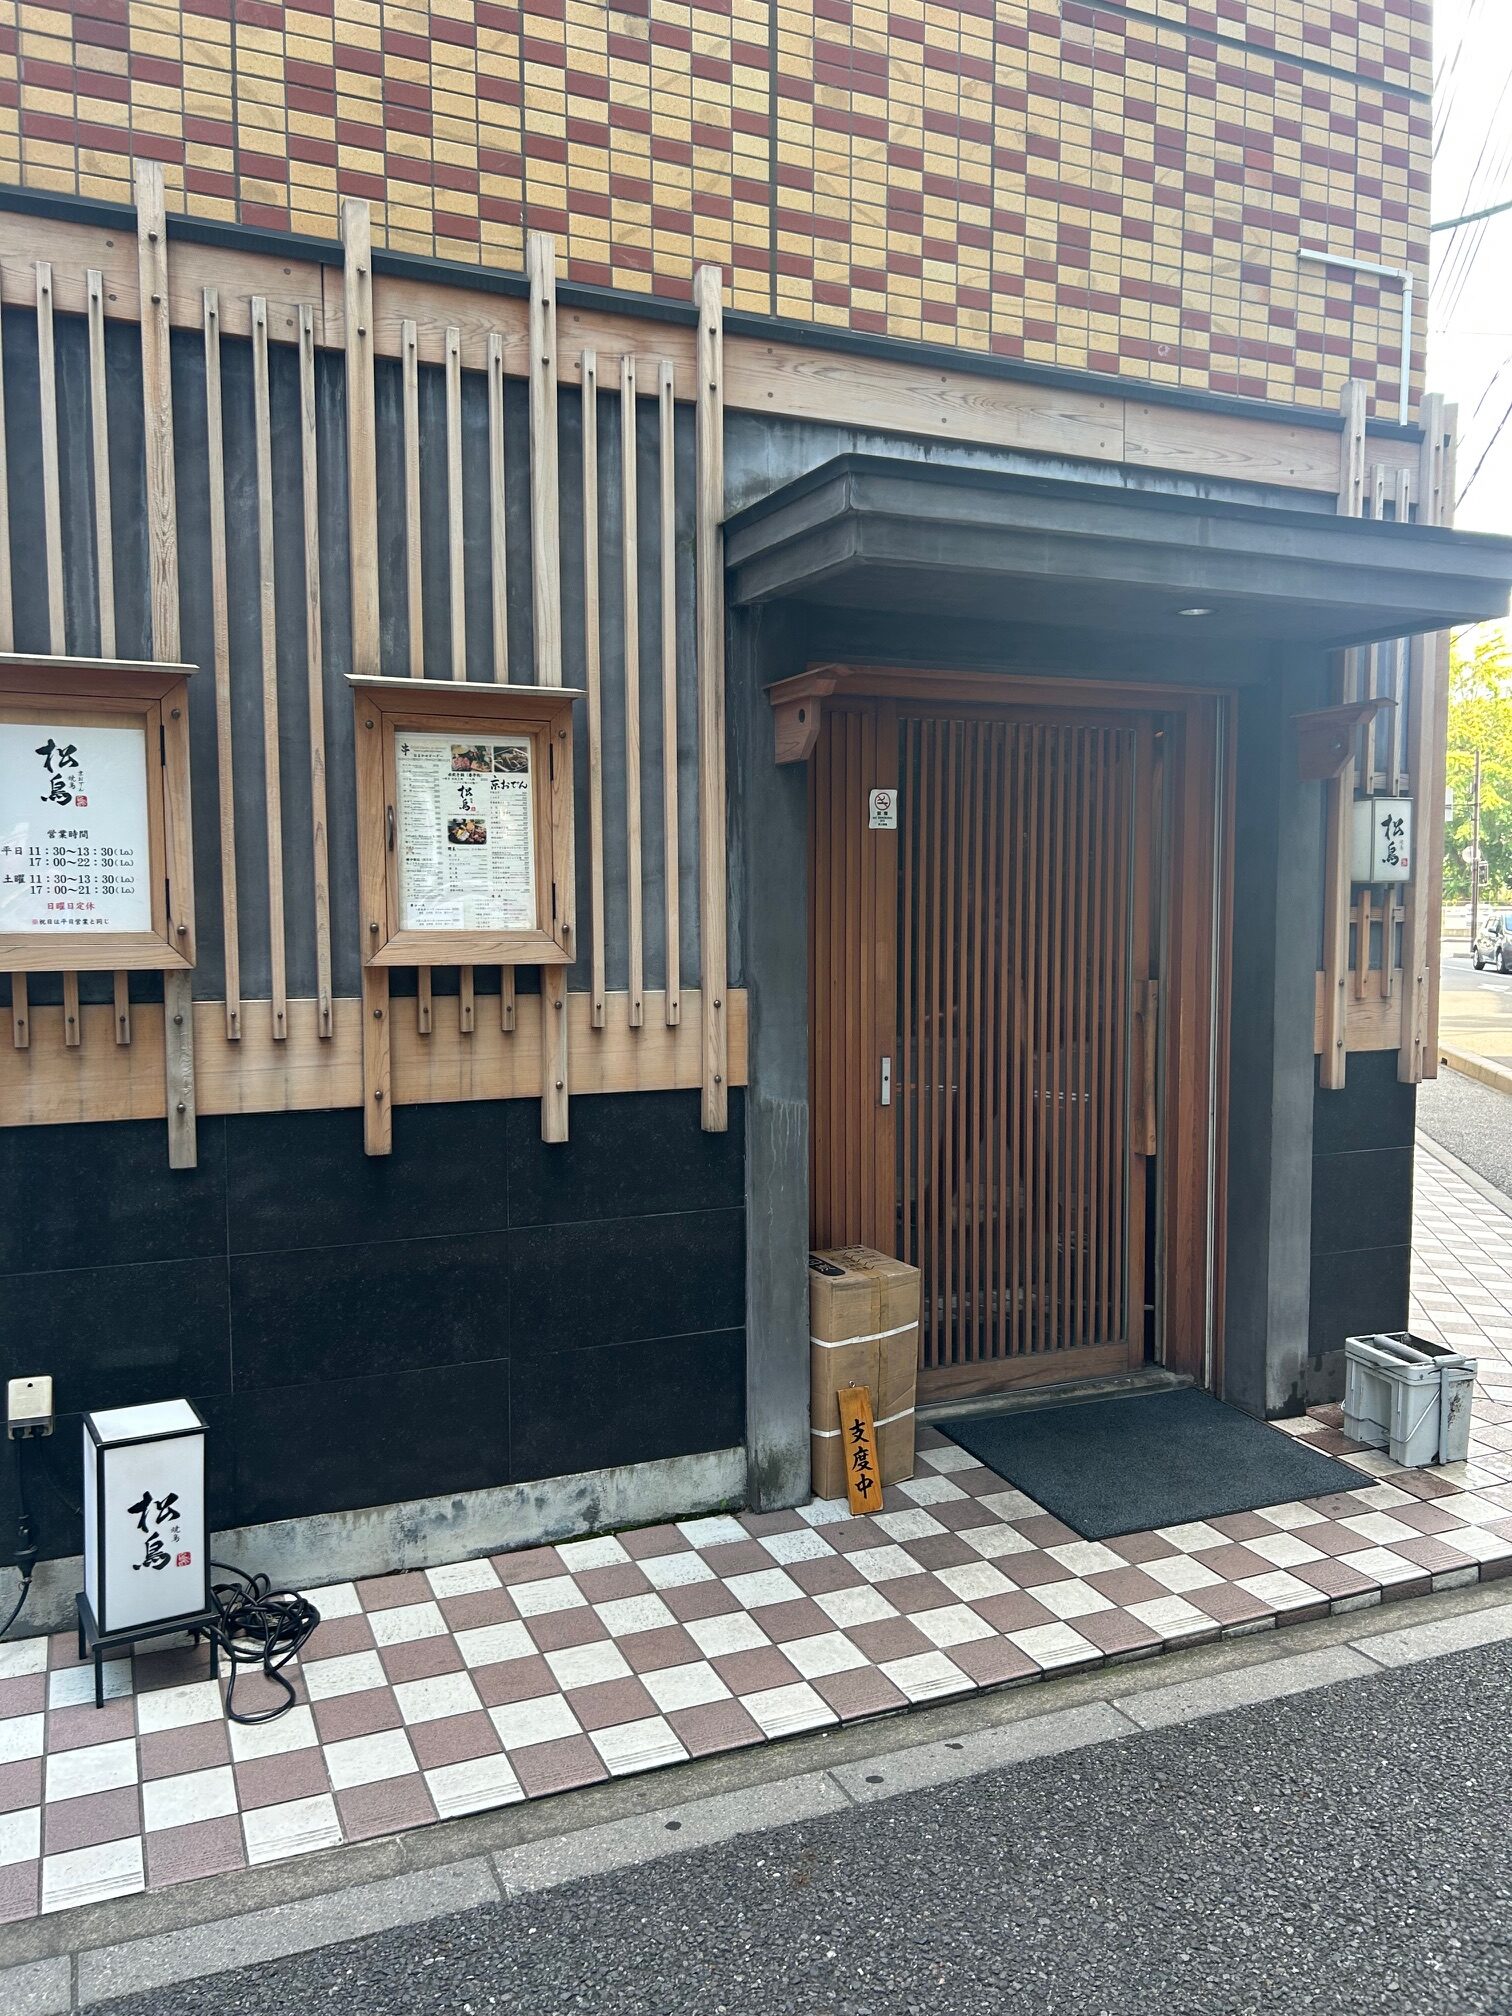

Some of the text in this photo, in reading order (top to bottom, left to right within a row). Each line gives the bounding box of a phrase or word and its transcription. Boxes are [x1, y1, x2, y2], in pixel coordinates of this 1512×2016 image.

[490, 775, 528, 790] 京おでん
[47, 829, 89, 839] 営業時間
[1, 845, 23, 856] 平日
[3, 874, 26, 884] 土曜
[47, 902, 95, 911] 日曜日定休
[848, 1418, 875, 1499] 支度中
